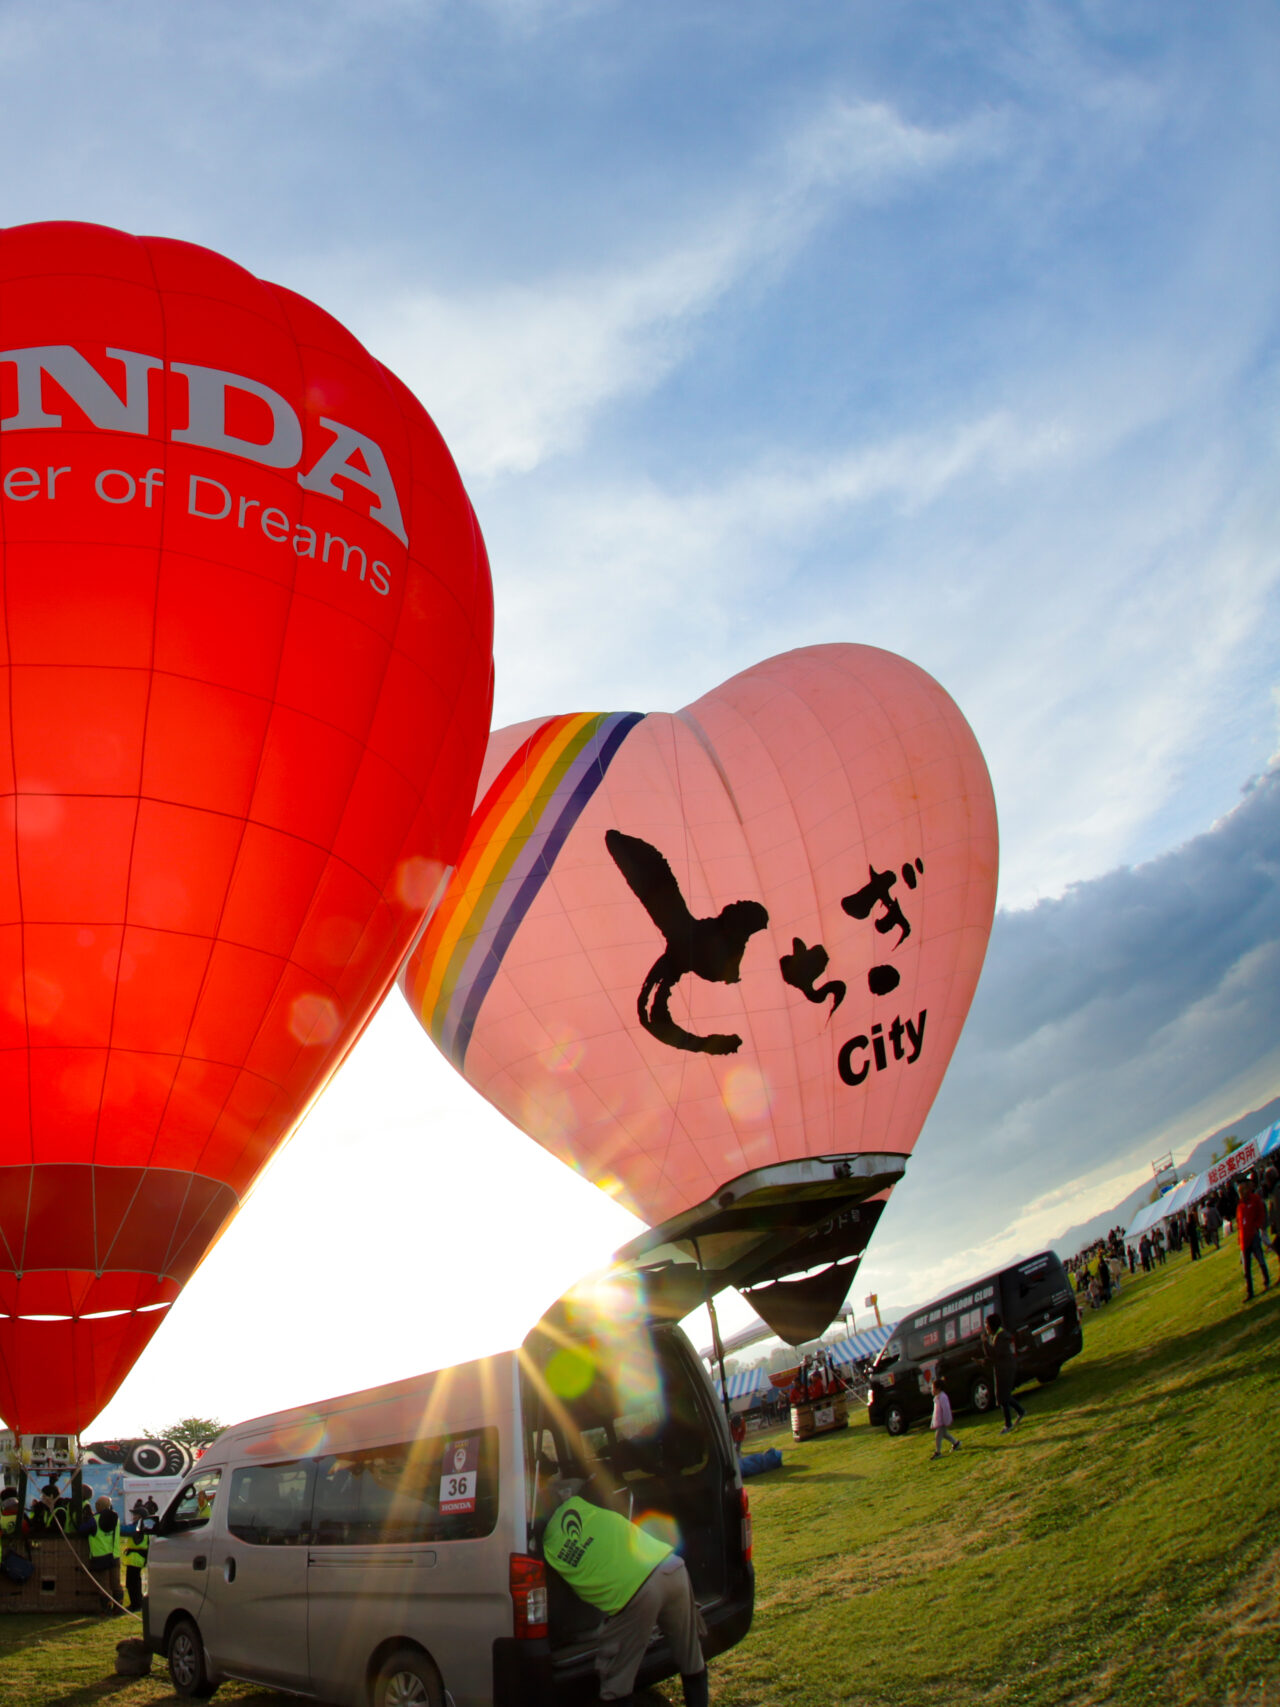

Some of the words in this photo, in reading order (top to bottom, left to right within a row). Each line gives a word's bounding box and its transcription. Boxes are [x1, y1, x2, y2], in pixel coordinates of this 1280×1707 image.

[94, 467, 164, 508] of
[187, 474, 392, 596] Dreams
[837, 1009, 928, 1087] City
[974, 1286, 994, 1303] CLUB
[448, 1477, 467, 1496] 36
[442, 1502, 471, 1511] HONDA
